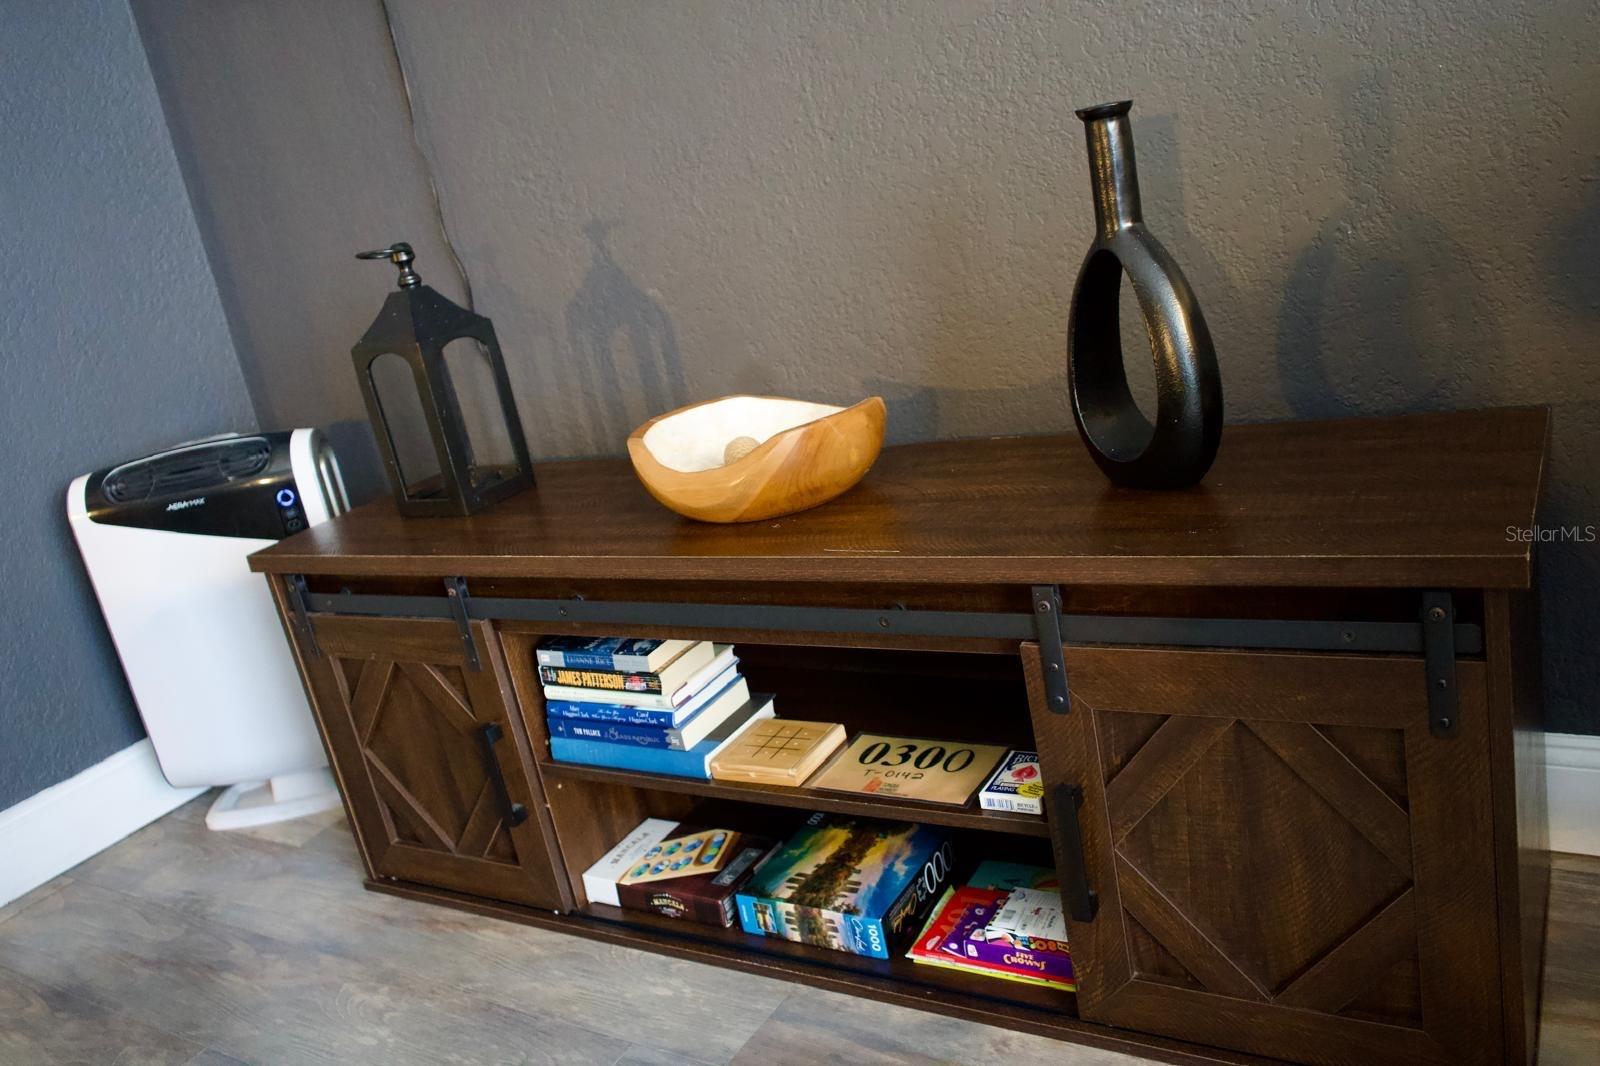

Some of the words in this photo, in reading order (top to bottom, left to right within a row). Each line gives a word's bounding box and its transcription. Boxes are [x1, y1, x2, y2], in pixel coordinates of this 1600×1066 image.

[557, 671, 583, 685] JAMES
[583, 672, 625, 690] PATTERSON
[858, 742, 976, 773] 0300
[863, 768, 925, 780] T-0142
[867, 924, 882, 952] 1000
[1003, 953, 1047, 971] CROWNS
[1015, 951, 1034, 961] FIVE
